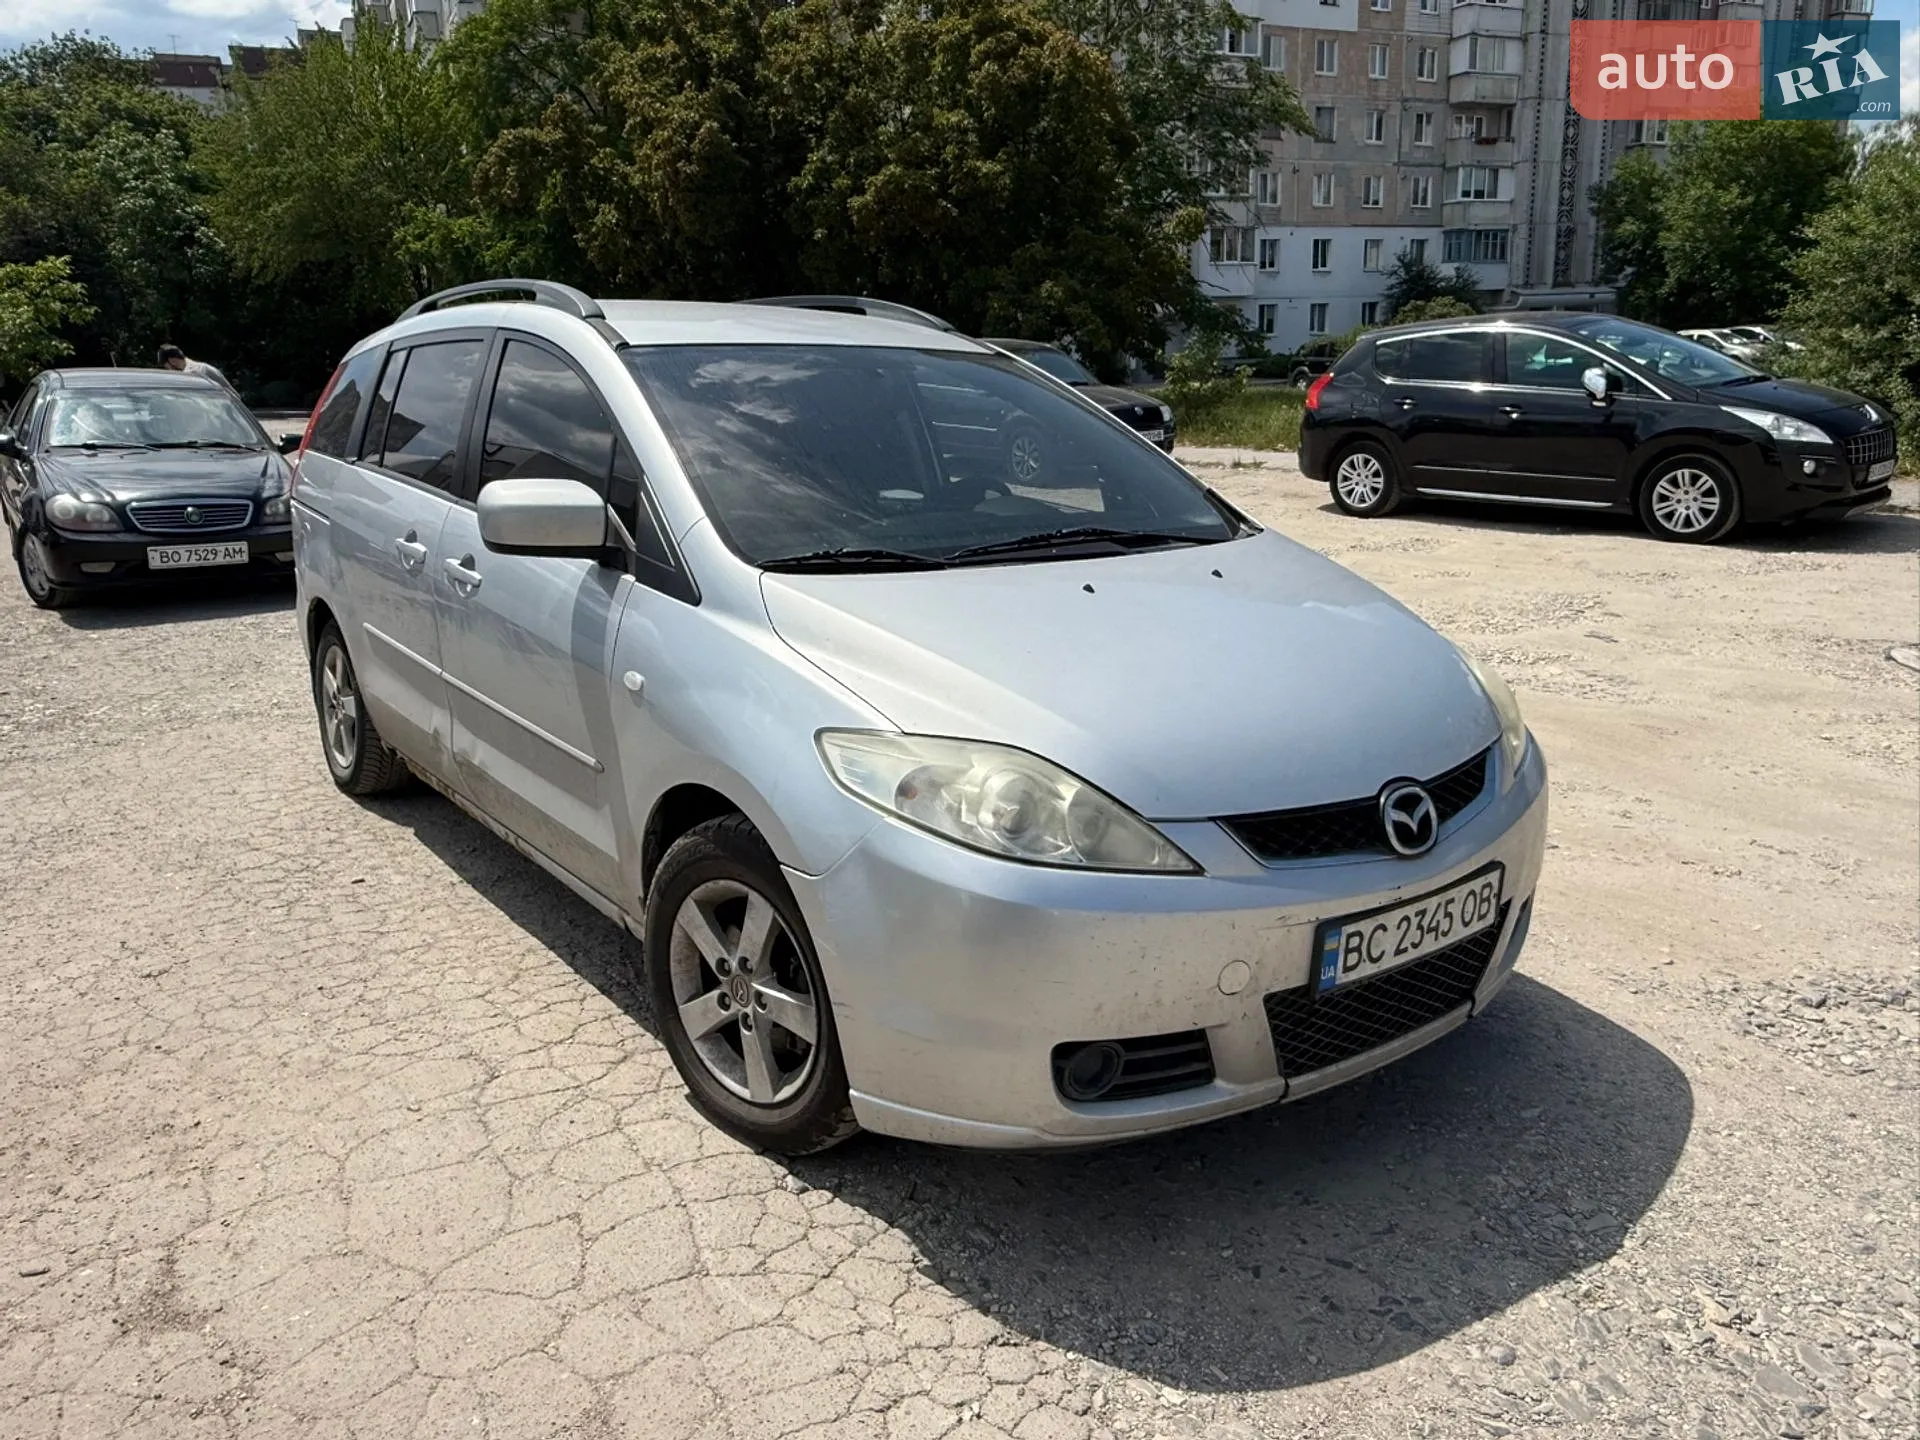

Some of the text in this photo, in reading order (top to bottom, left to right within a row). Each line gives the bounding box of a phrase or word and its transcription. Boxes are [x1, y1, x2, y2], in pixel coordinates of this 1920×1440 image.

[159, 547, 243, 563] BO 7529 AM
[1341, 881, 1493, 974] BC 2345 OB
[1320, 968, 1336, 980] UA
